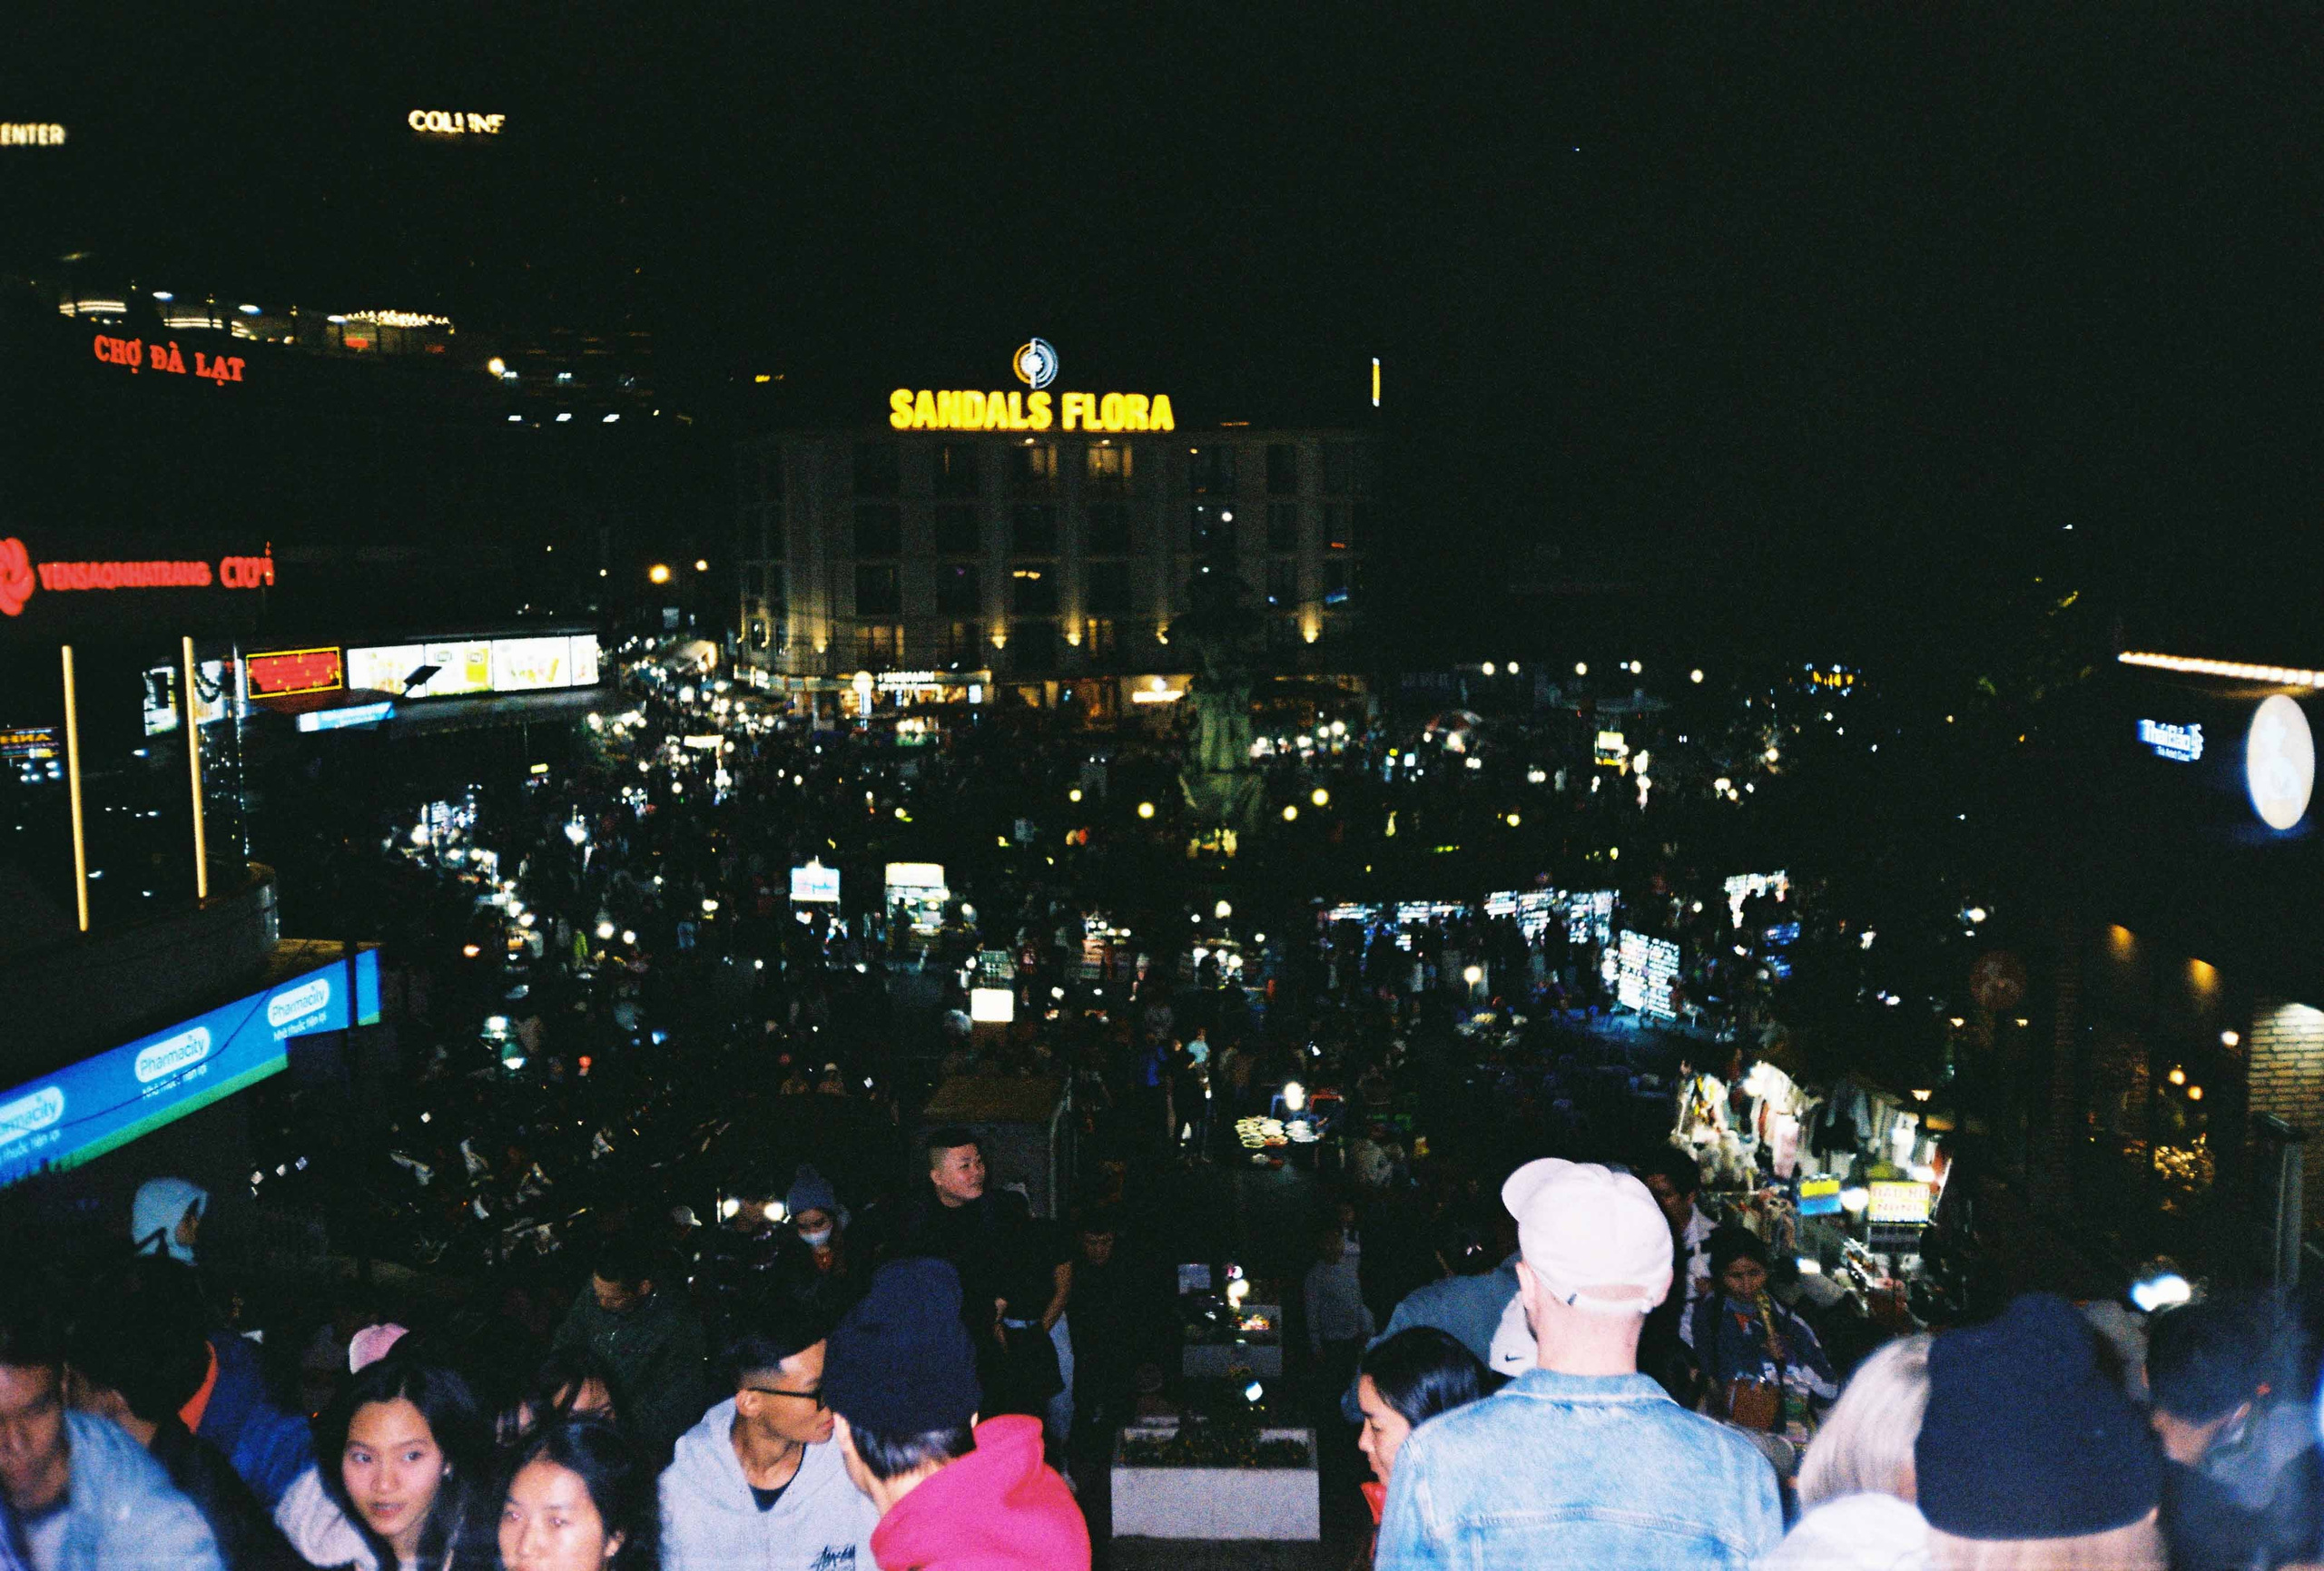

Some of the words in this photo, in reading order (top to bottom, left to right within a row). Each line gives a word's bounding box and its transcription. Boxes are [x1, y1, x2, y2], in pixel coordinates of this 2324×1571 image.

[94, 334, 143, 374] CHỢ
[149, 340, 187, 374] ĐÀ
[194, 351, 246, 387] LẠT
[889, 388, 1053, 430] SANDALS
[1061, 391, 1175, 432] FLORA
[271, 988, 327, 1021] Pharmacity
[140, 1037, 205, 1076] Pharmacity
